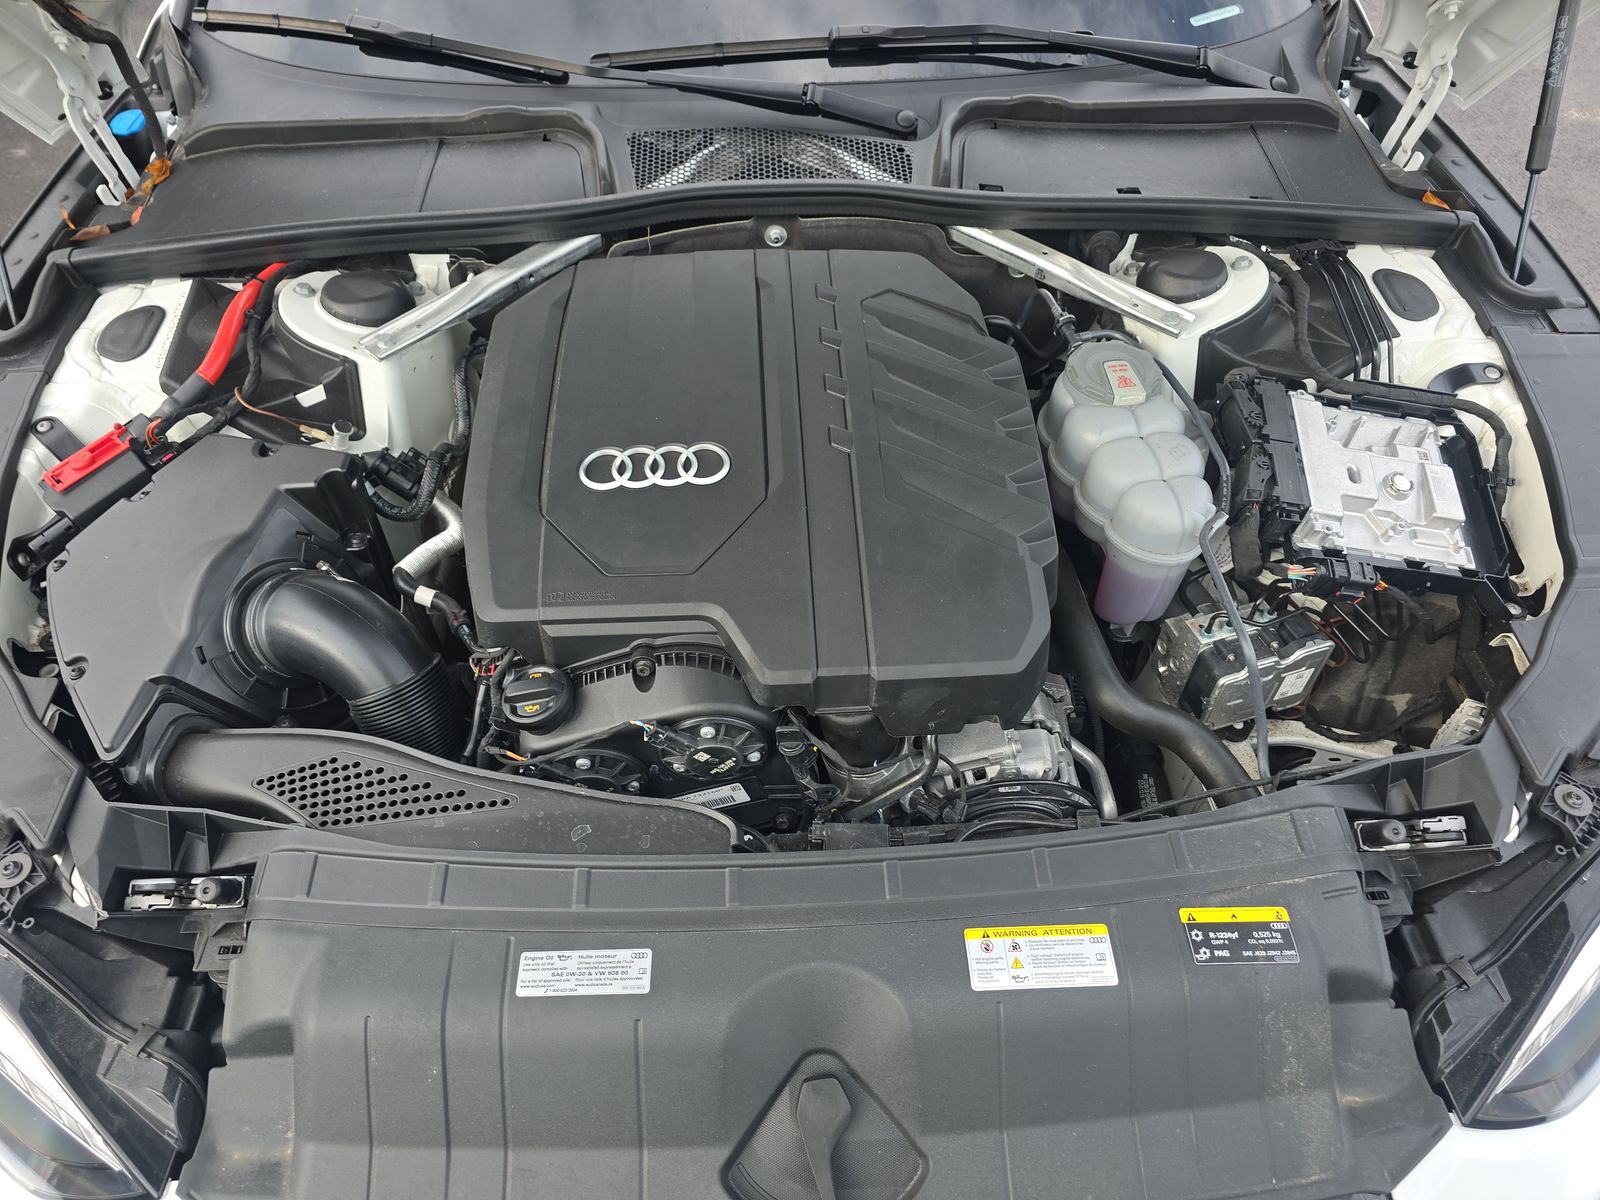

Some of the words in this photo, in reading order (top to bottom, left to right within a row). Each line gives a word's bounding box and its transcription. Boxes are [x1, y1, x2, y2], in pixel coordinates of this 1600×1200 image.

[993, 929, 1038, 938] WARNING
[1042, 928, 1092, 936] ATTENTION
[1271, 931, 1282, 939] kg
